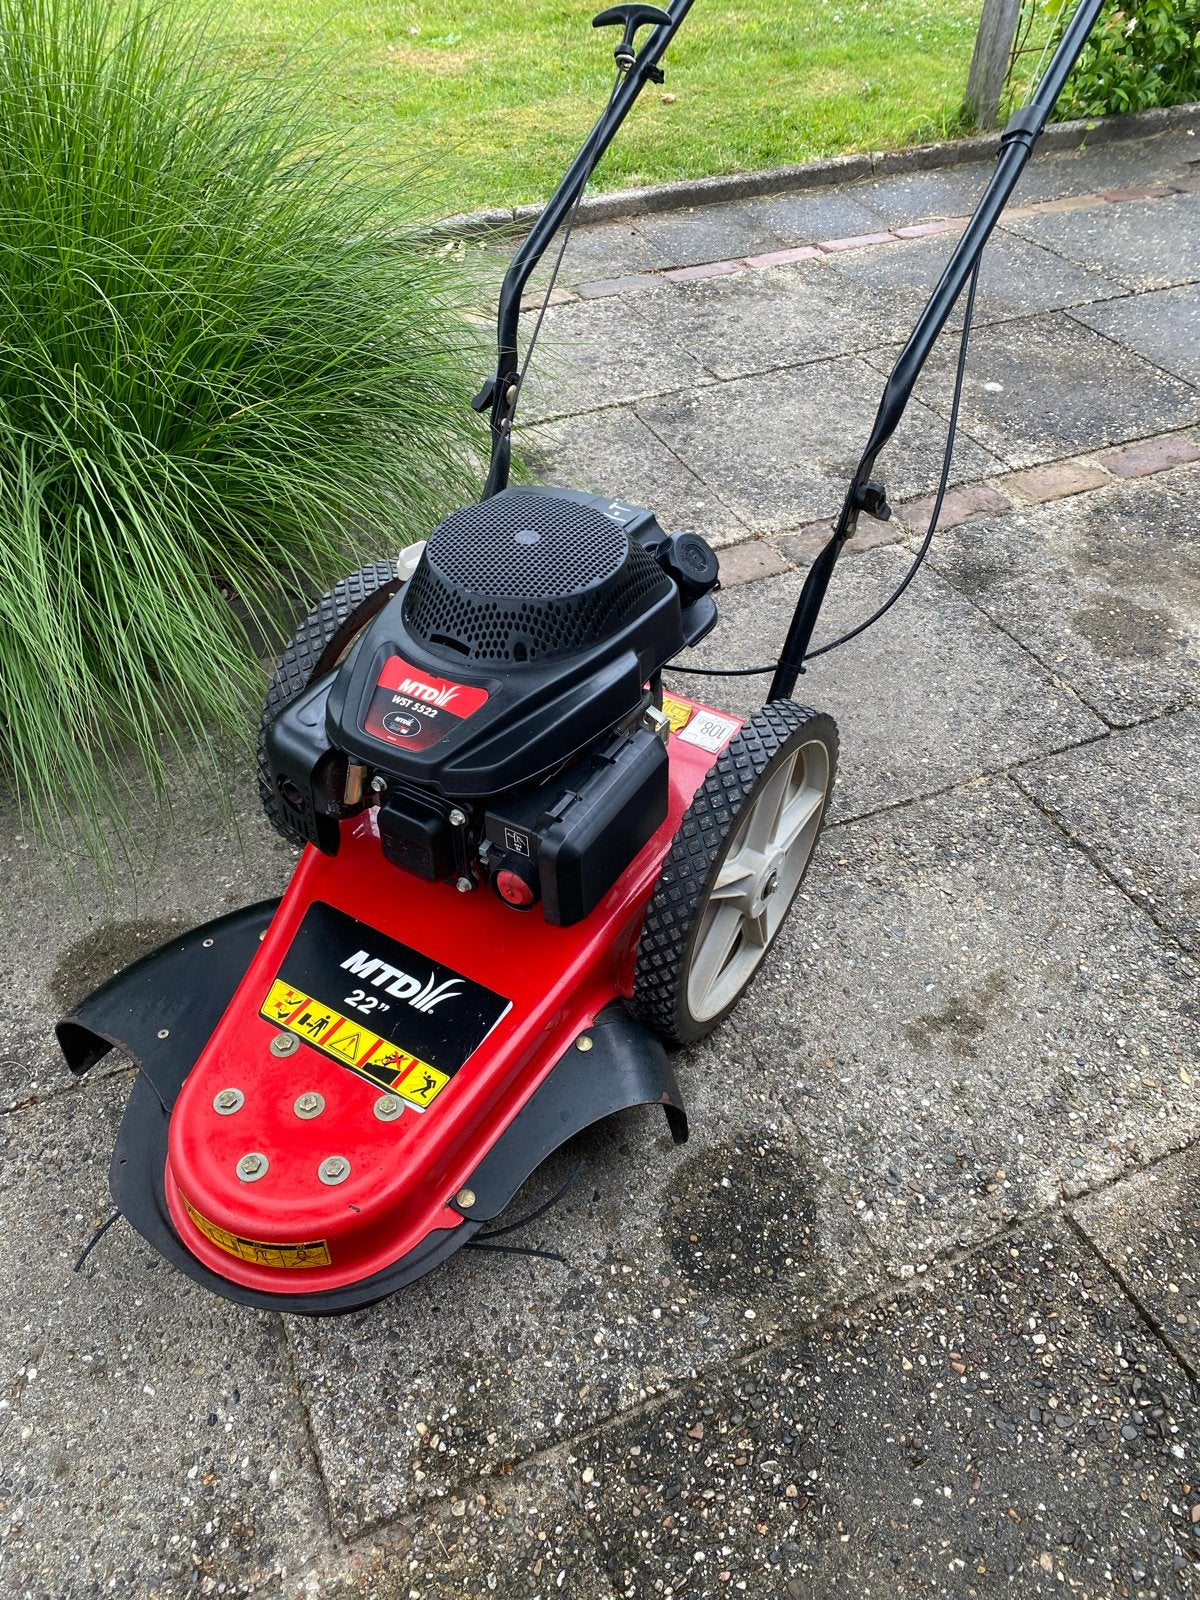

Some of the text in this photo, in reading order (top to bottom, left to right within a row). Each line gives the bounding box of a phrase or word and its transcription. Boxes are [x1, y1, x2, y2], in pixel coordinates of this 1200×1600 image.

[398, 678, 440, 703] MTD
[391, 694, 438, 718] WST 5522
[700, 721, 726, 740] 108
[340, 950, 422, 1000] MTD
